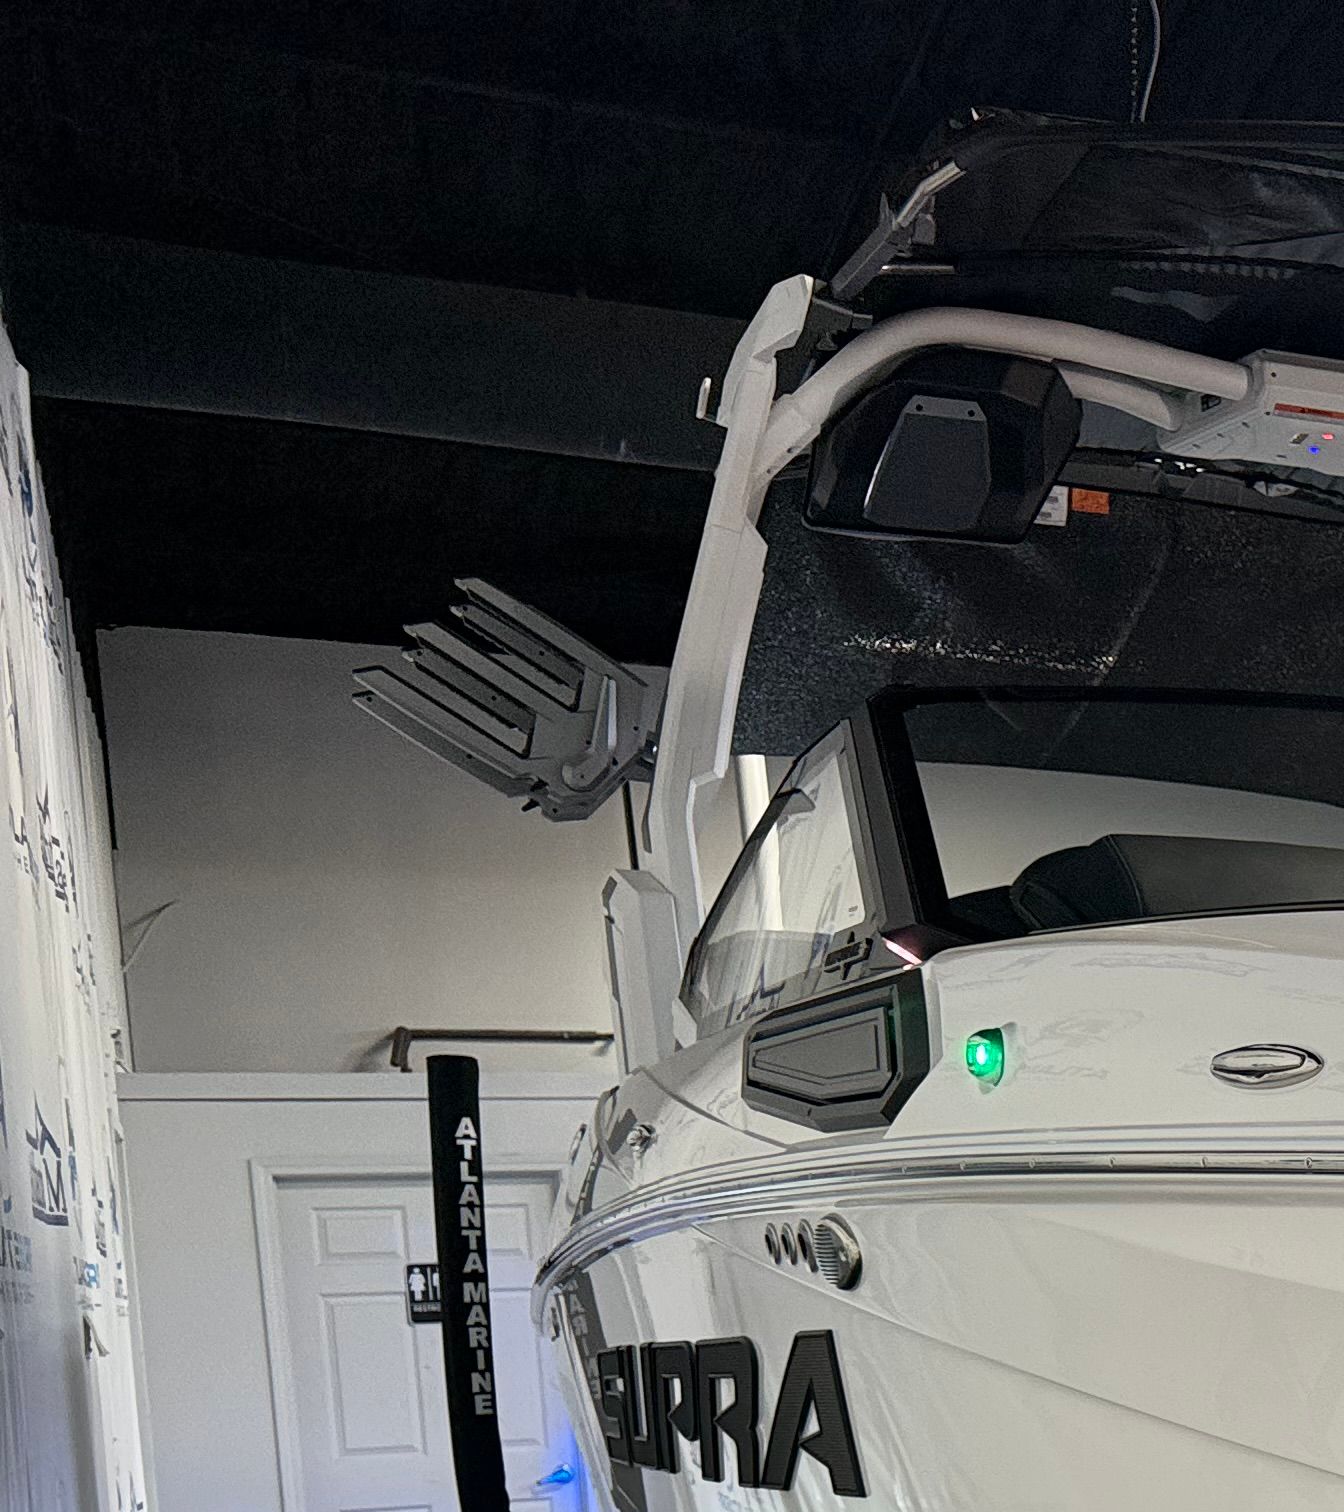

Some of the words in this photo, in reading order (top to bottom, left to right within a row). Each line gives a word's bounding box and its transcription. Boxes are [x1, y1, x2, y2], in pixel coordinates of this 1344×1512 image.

[455, 1117, 484, 1273] ATLANTA
[463, 1282, 493, 1415] MARINE
[597, 1329, 869, 1498] SUPRA
